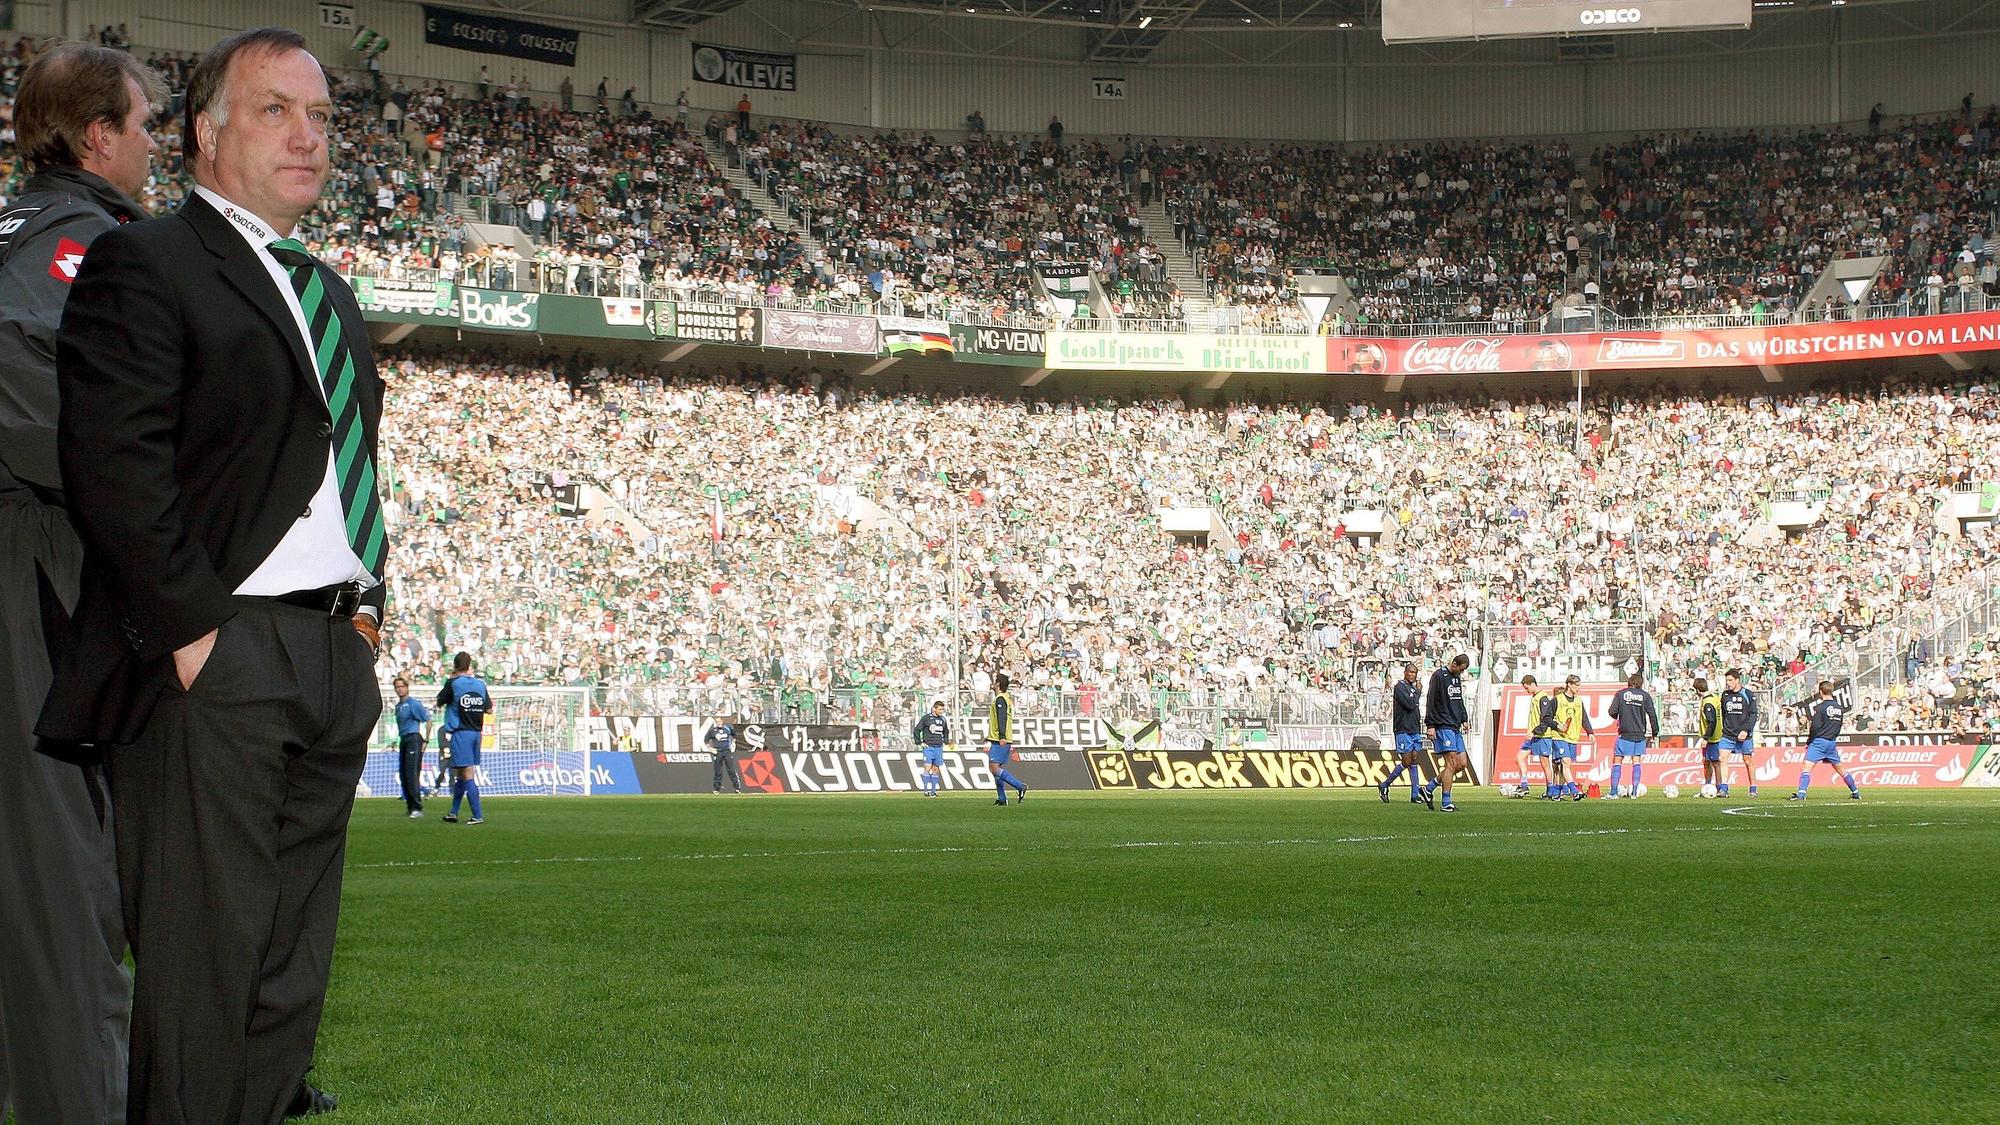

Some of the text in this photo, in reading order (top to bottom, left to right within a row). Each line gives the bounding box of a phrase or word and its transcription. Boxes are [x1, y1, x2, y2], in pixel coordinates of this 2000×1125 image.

[725, 60, 793, 89] KLEVE
[1095, 83, 1123, 97] 14A
[231, 212, 266, 239] KYOCERA
[677, 313, 737, 328] BORUSSEN
[1060, 338, 1184, 364] Golfpark
[1696, 323, 2000, 359] DAS WÜRSTCHEN VOM LAN
[1203, 349, 1310, 369] Birkhof
[666, 753, 712, 763] KYOCERA
[1019, 752, 1060, 761] KYOCERA
[1859, 748, 1938, 763] Consumer
[520, 764, 614, 786] citibank
[1148, 752, 1252, 789] Jack
[1854, 770, 1921, 785] CC-Bank
